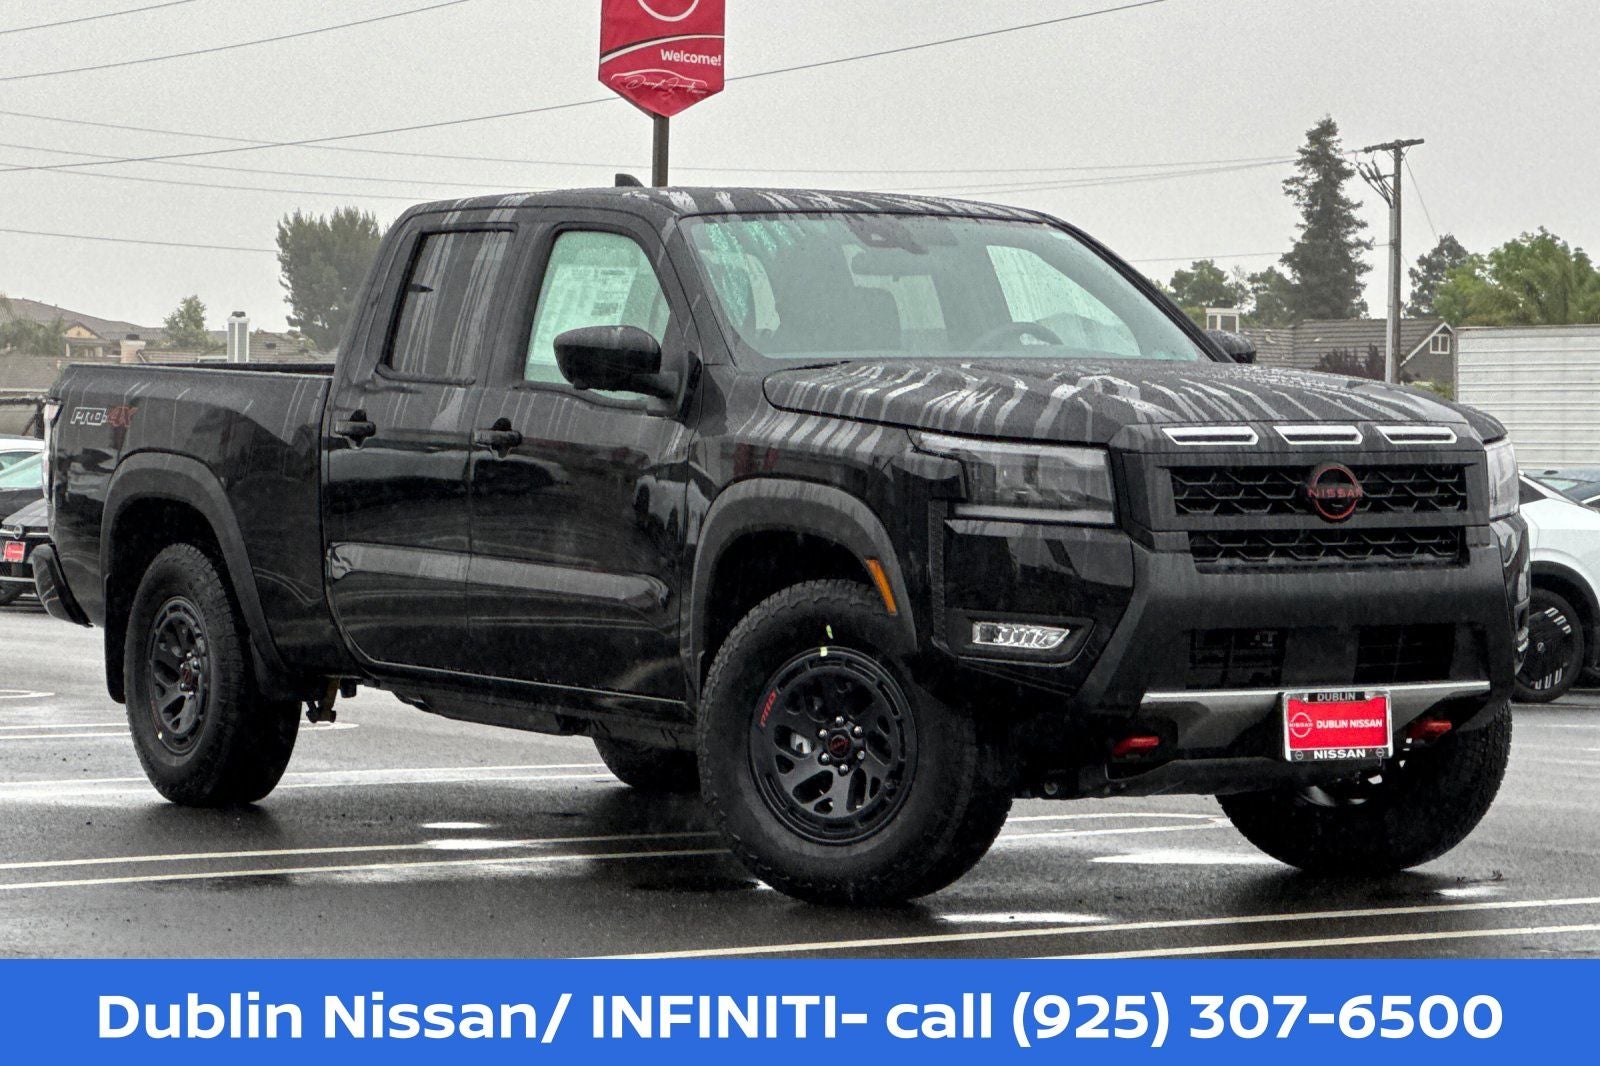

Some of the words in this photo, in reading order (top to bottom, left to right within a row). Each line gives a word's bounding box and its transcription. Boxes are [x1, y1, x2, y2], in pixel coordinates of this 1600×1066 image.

[660, 49, 722, 66] Welcome!
[1308, 487, 1363, 497] NISSAN
[1317, 692, 1356, 702] DUBLIN
[1316, 719, 1348, 729] DUBLIN
[1349, 718, 1383, 728] NISSAN
[1313, 748, 1366, 760] NISSAN
